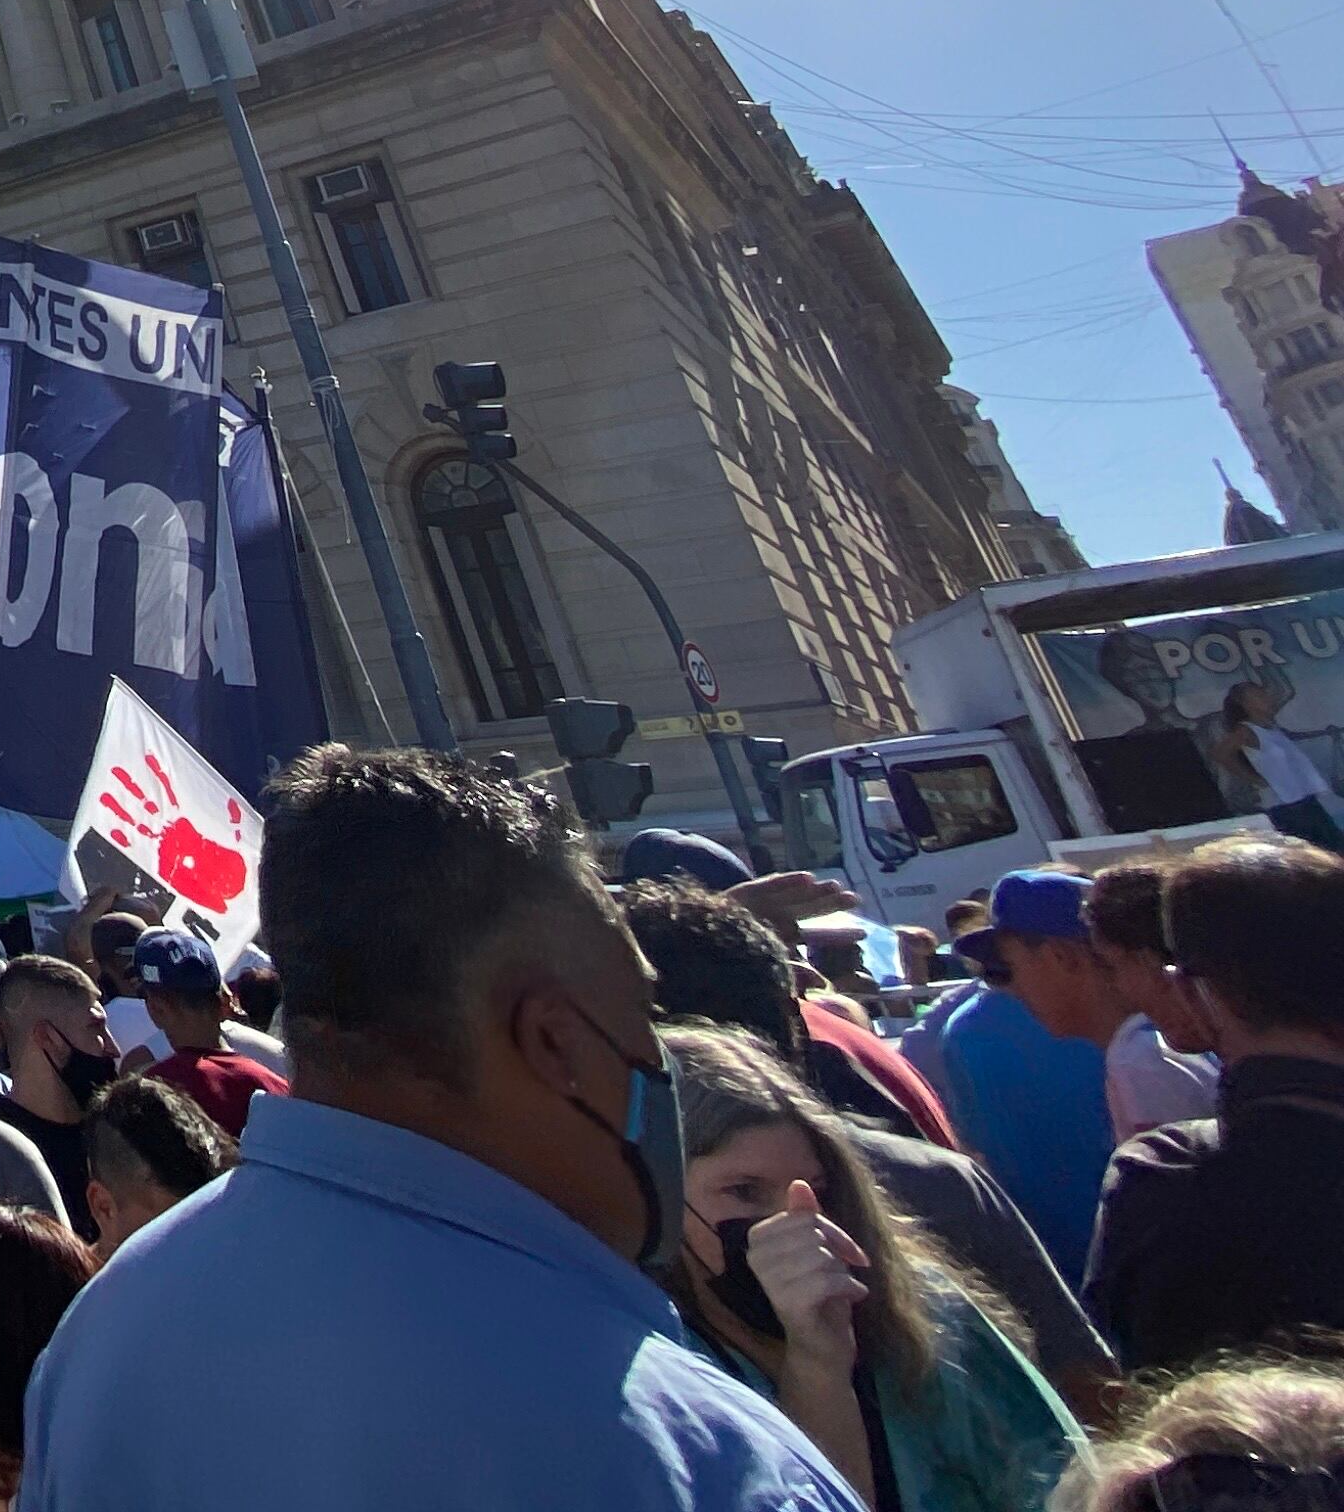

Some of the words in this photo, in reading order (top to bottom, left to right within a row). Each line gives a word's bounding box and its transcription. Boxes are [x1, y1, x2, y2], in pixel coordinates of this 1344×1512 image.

[129, 314, 216, 384] UN
[691, 660, 713, 686] 20
[1153, 629, 1287, 679] POR
